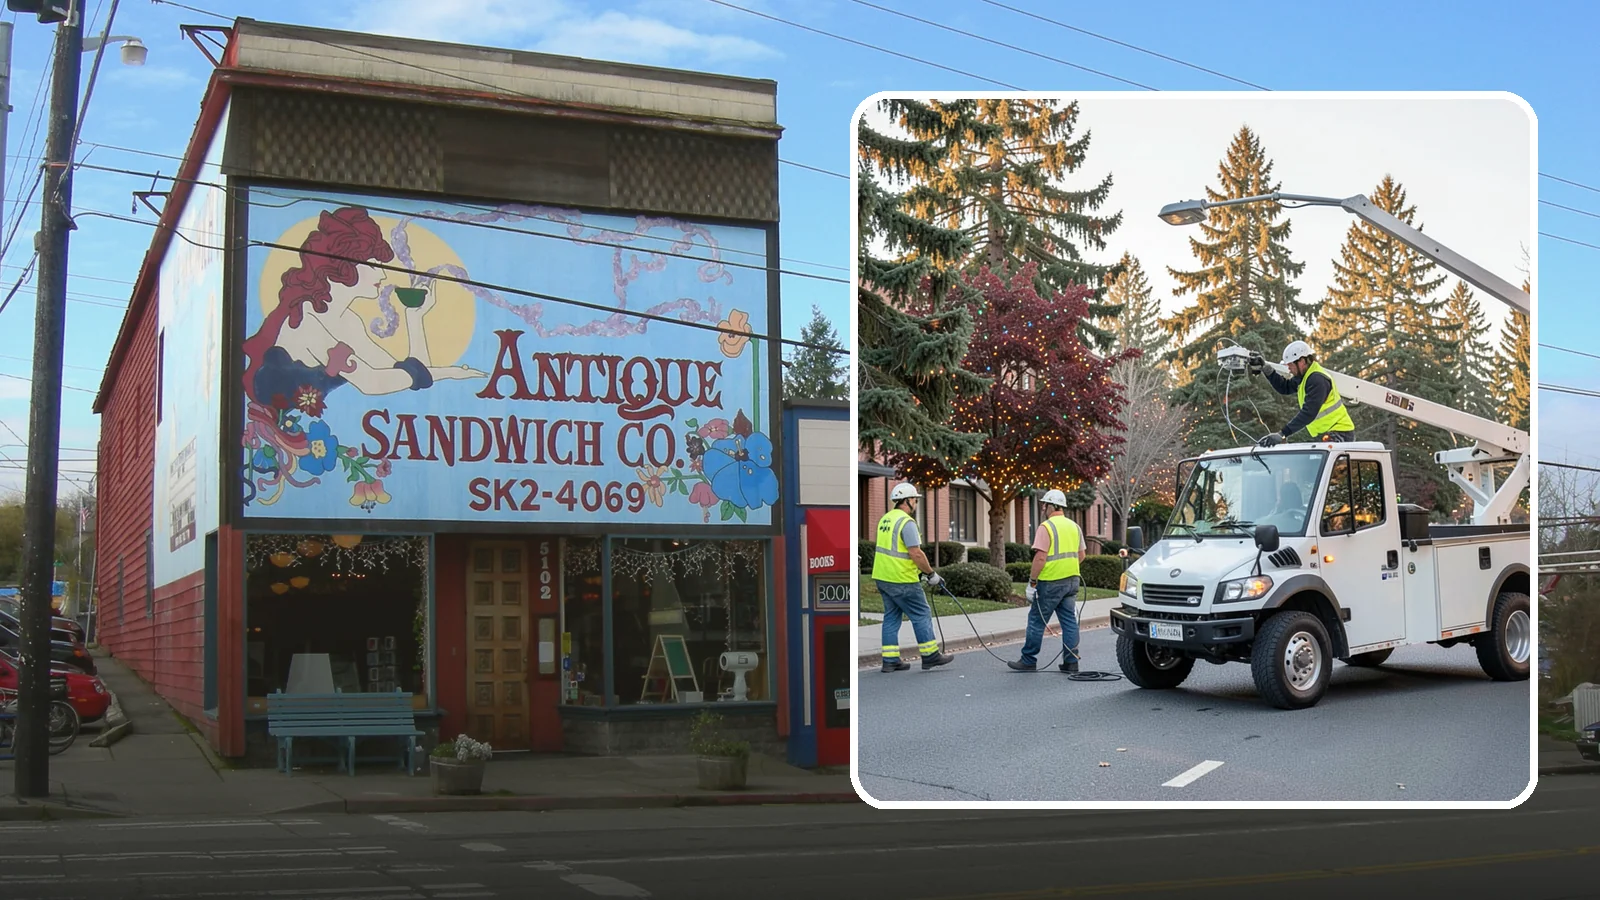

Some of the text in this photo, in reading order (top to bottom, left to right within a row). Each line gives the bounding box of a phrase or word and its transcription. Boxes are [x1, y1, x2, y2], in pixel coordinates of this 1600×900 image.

[475, 329, 723, 421] ANTIQUE
[361, 408, 684, 469] SANDWICH CO.
[468, 478, 645, 513] SK2-4069
[540, 541, 551, 600] 5102
[809, 555, 835, 569] BOOKS
